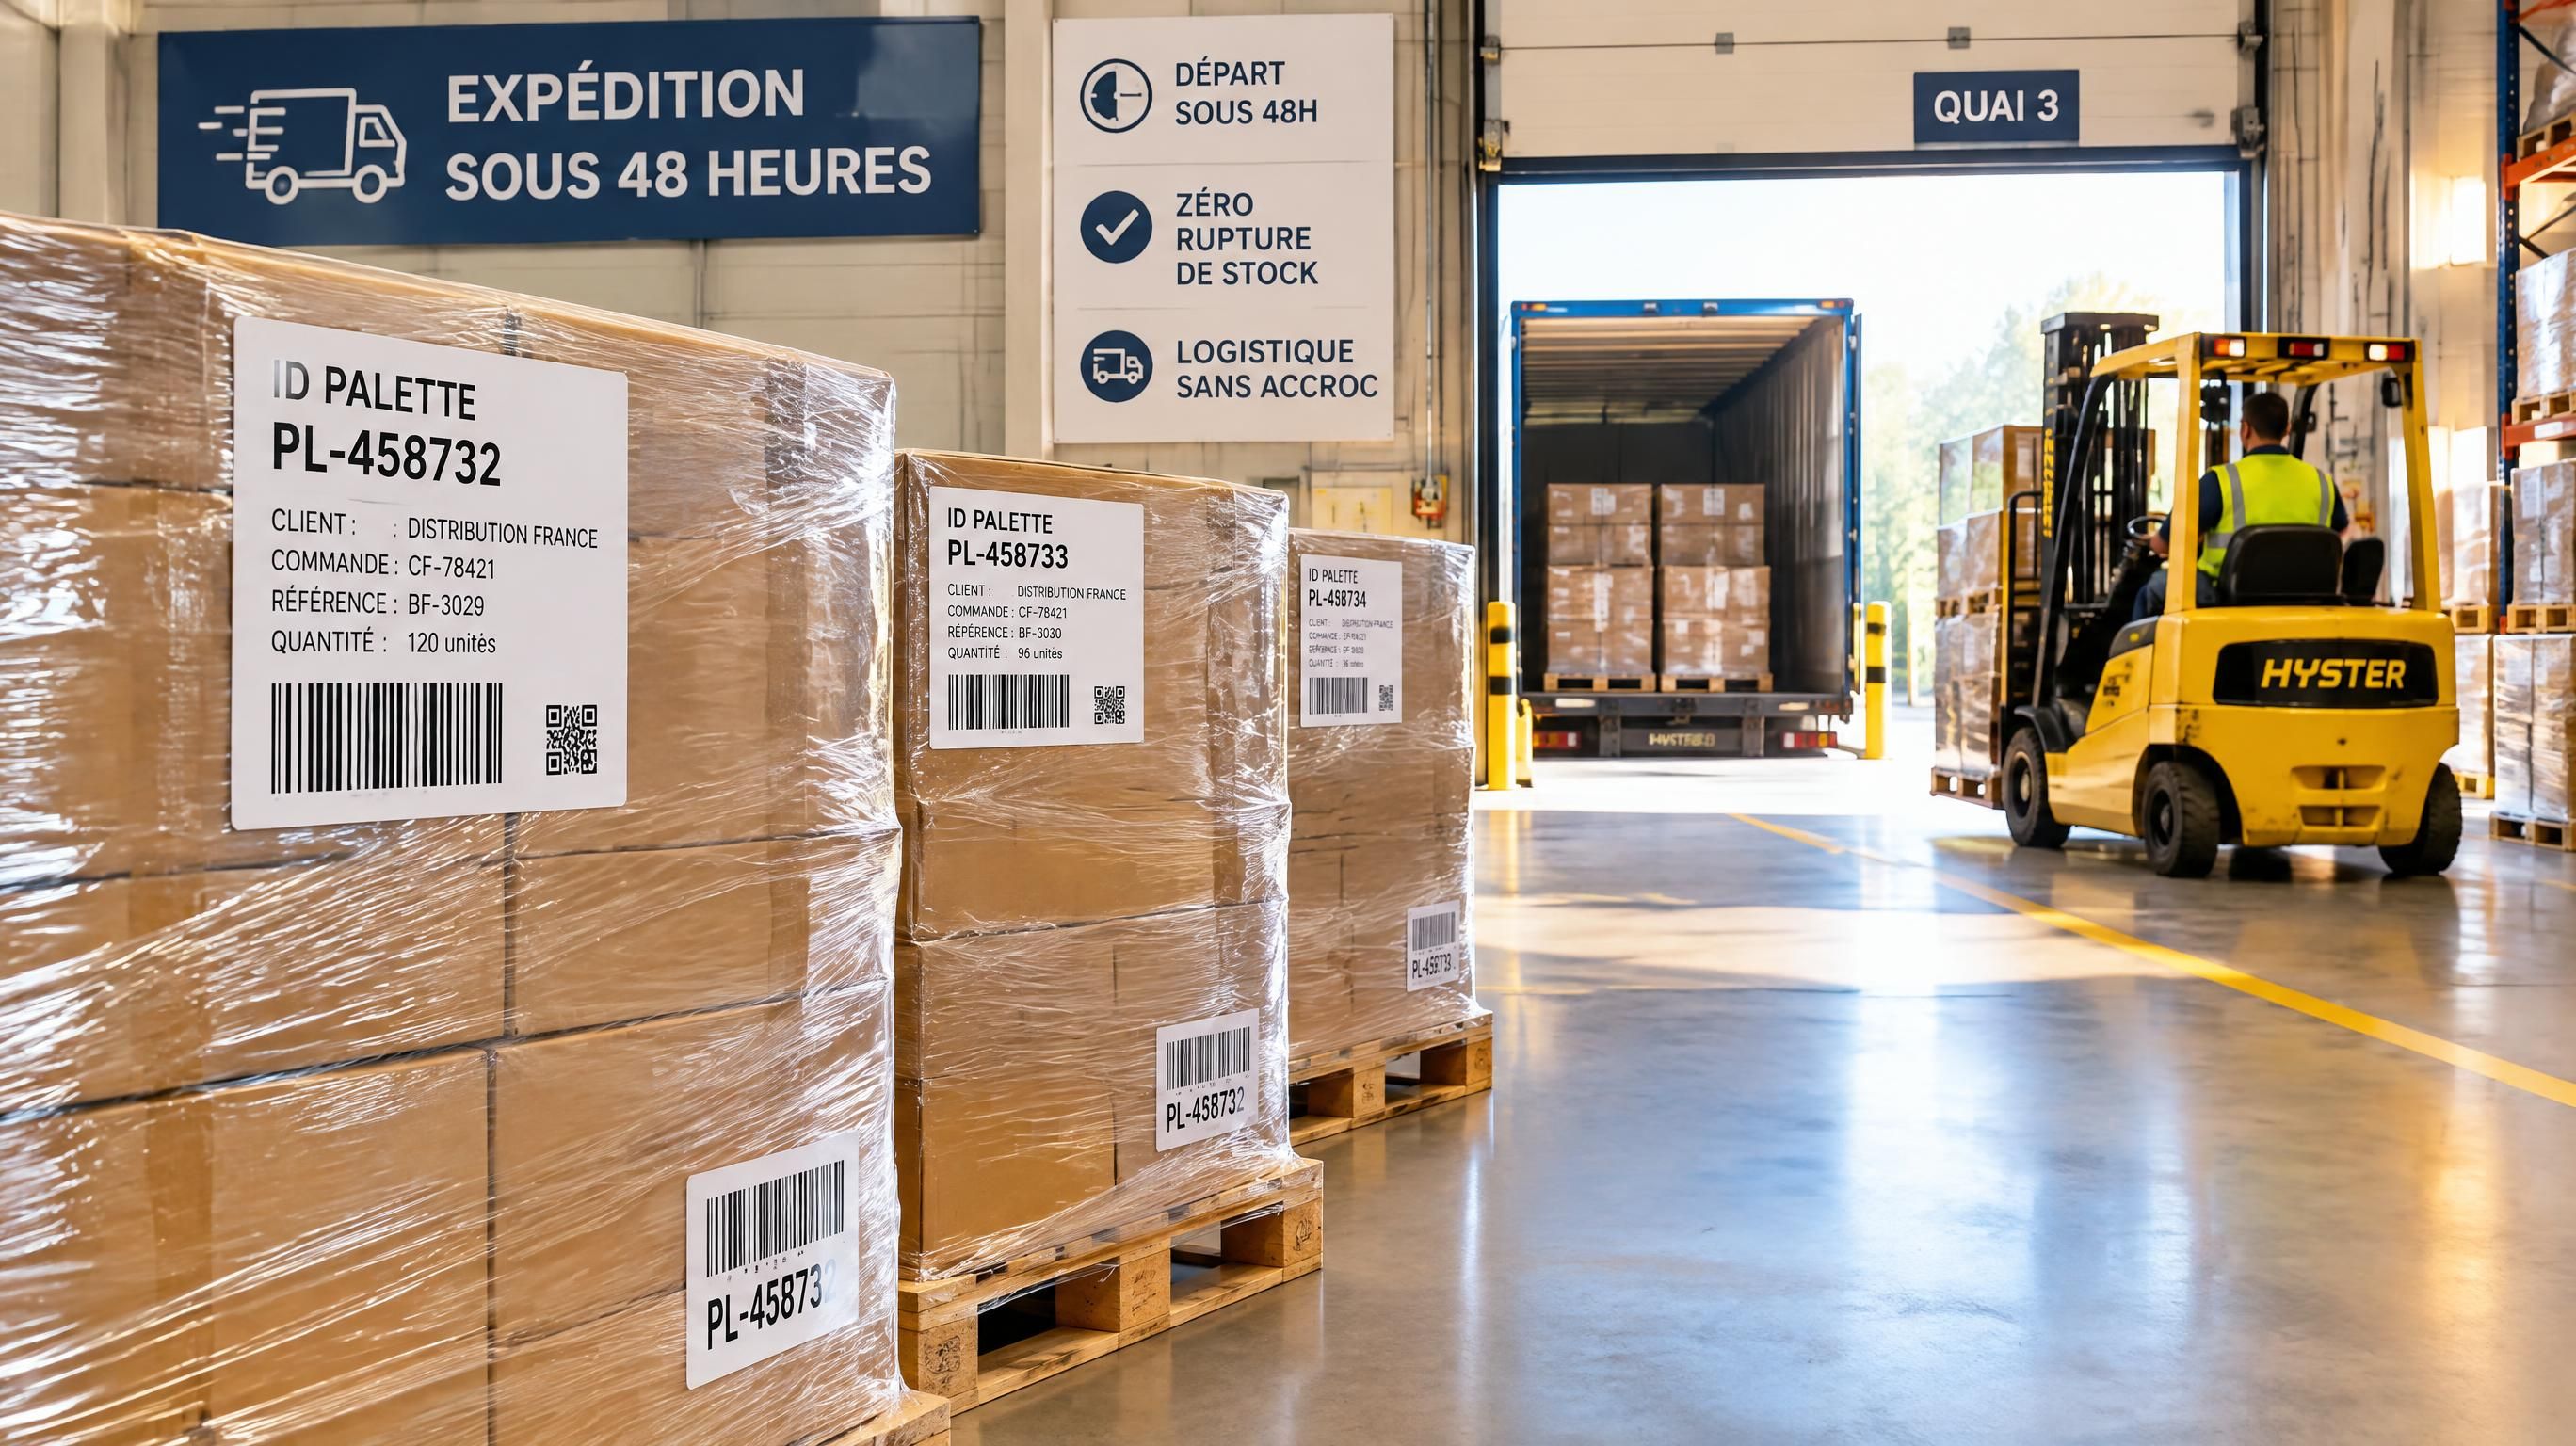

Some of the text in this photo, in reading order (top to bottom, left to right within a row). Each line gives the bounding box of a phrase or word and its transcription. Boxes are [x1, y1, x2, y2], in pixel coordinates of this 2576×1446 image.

[1175, 56, 1285, 86] DÉPART
[448, 59, 803, 122] EXPÉDITION
[1175, 98, 1316, 125] SOUS 48H
[1934, 88, 2058, 124] QUAI 3
[445, 145, 931, 201] SOUS 48 HEURES
[1176, 186, 1253, 217] ZÉRO
[1177, 226, 1311, 250] RUPTURE
[1177, 260, 1318, 285] DE STOCK
[1177, 339, 1353, 365] LOGISTIQUE
[273, 359, 475, 421] ID PALETTE
[1176, 374, 1377, 398] SANS ACCROC
[273, 421, 501, 487] PL-458732
[408, 517, 527, 544] DISTRIBUTION
[533, 525, 597, 548] FRANCE
[947, 506, 1052, 534] ID PALETTE
[408, 554, 493, 579] CF-78421
[948, 538, 1068, 569] PL-458733
[1309, 567, 1358, 584] ID PALETTE
[408, 593, 484, 616] BF-3029
[1017, 585, 1084, 599] DISTRIBUTION
[1087, 587, 1126, 600] FRANCE
[1018, 605, 1066, 619] CF-78421
[408, 632, 438, 652] 120
[444, 632, 495, 653] unités
[1019, 626, 1061, 638] BF-3030
[1018, 647, 1030, 658] 96
[2261, 658, 2406, 688] HYSTER
